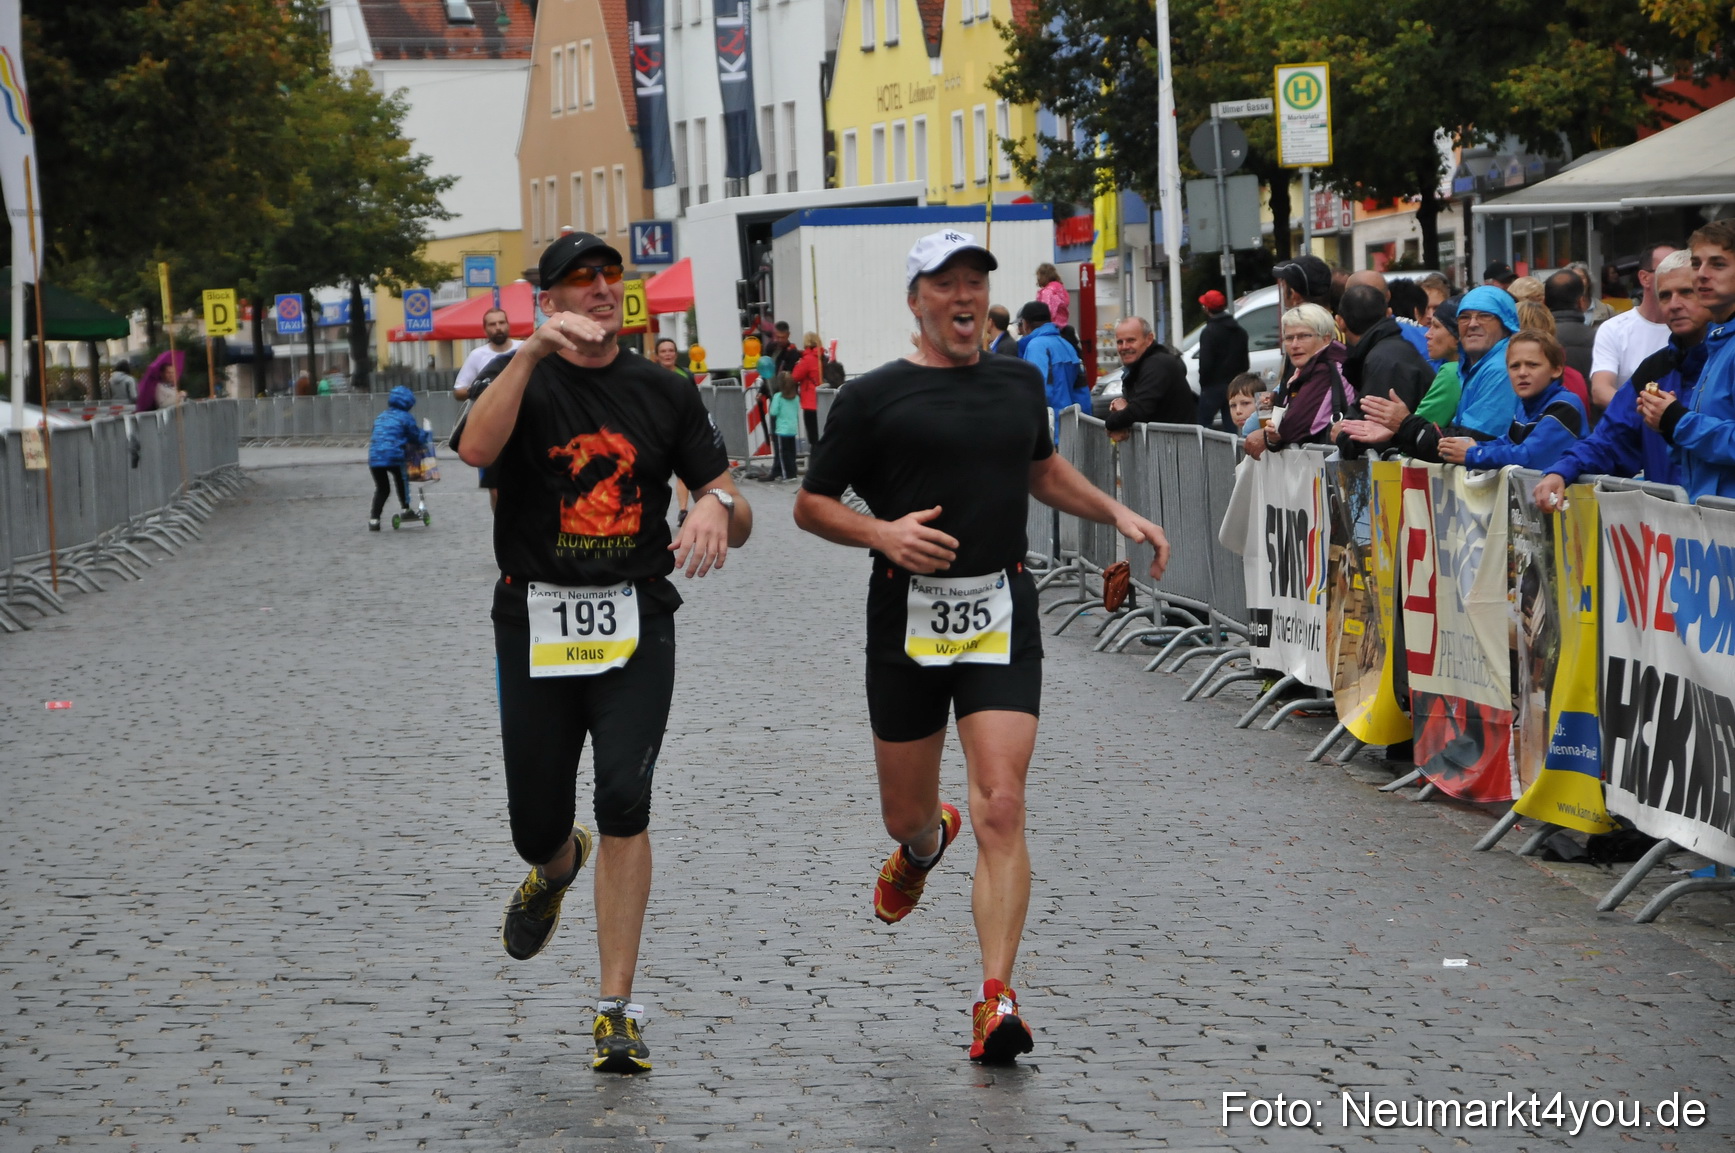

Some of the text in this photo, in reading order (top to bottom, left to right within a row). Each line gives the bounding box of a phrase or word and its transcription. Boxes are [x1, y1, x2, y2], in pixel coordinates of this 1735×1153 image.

[876, 82, 903, 112] HOTEL
[1222, 101, 1269, 115] Ulmer Gasse
[1287, 113, 1320, 121] Marktplatz
[206, 291, 230, 300] Block
[626, 294, 641, 316] D
[212, 303, 228, 325] D
[280, 320, 301, 330] TAXI
[407, 318, 430, 329] TAXI
[568, 590, 617, 599] Neumarkt
[911, 583, 993, 597] PARTL Neumarkt
[552, 600, 617, 637] 193
[930, 597, 992, 634] 335
[566, 647, 604, 661] Klaus
